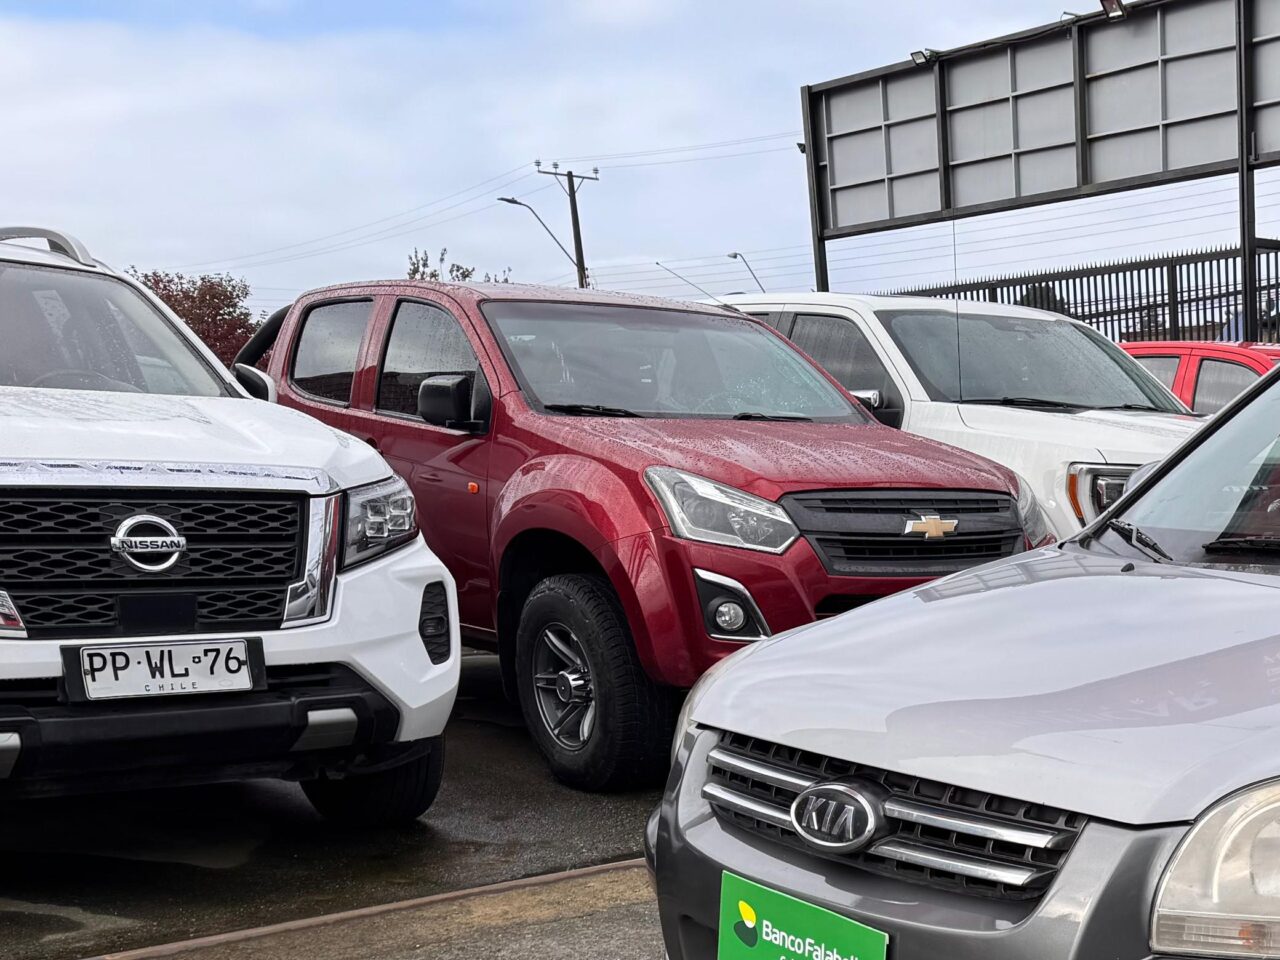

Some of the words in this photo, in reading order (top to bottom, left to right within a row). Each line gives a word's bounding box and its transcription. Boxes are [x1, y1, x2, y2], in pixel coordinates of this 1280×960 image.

[121, 540, 181, 550] NISSAN
[145, 681, 199, 692] CHILE
[802, 795, 854, 839] KIA
